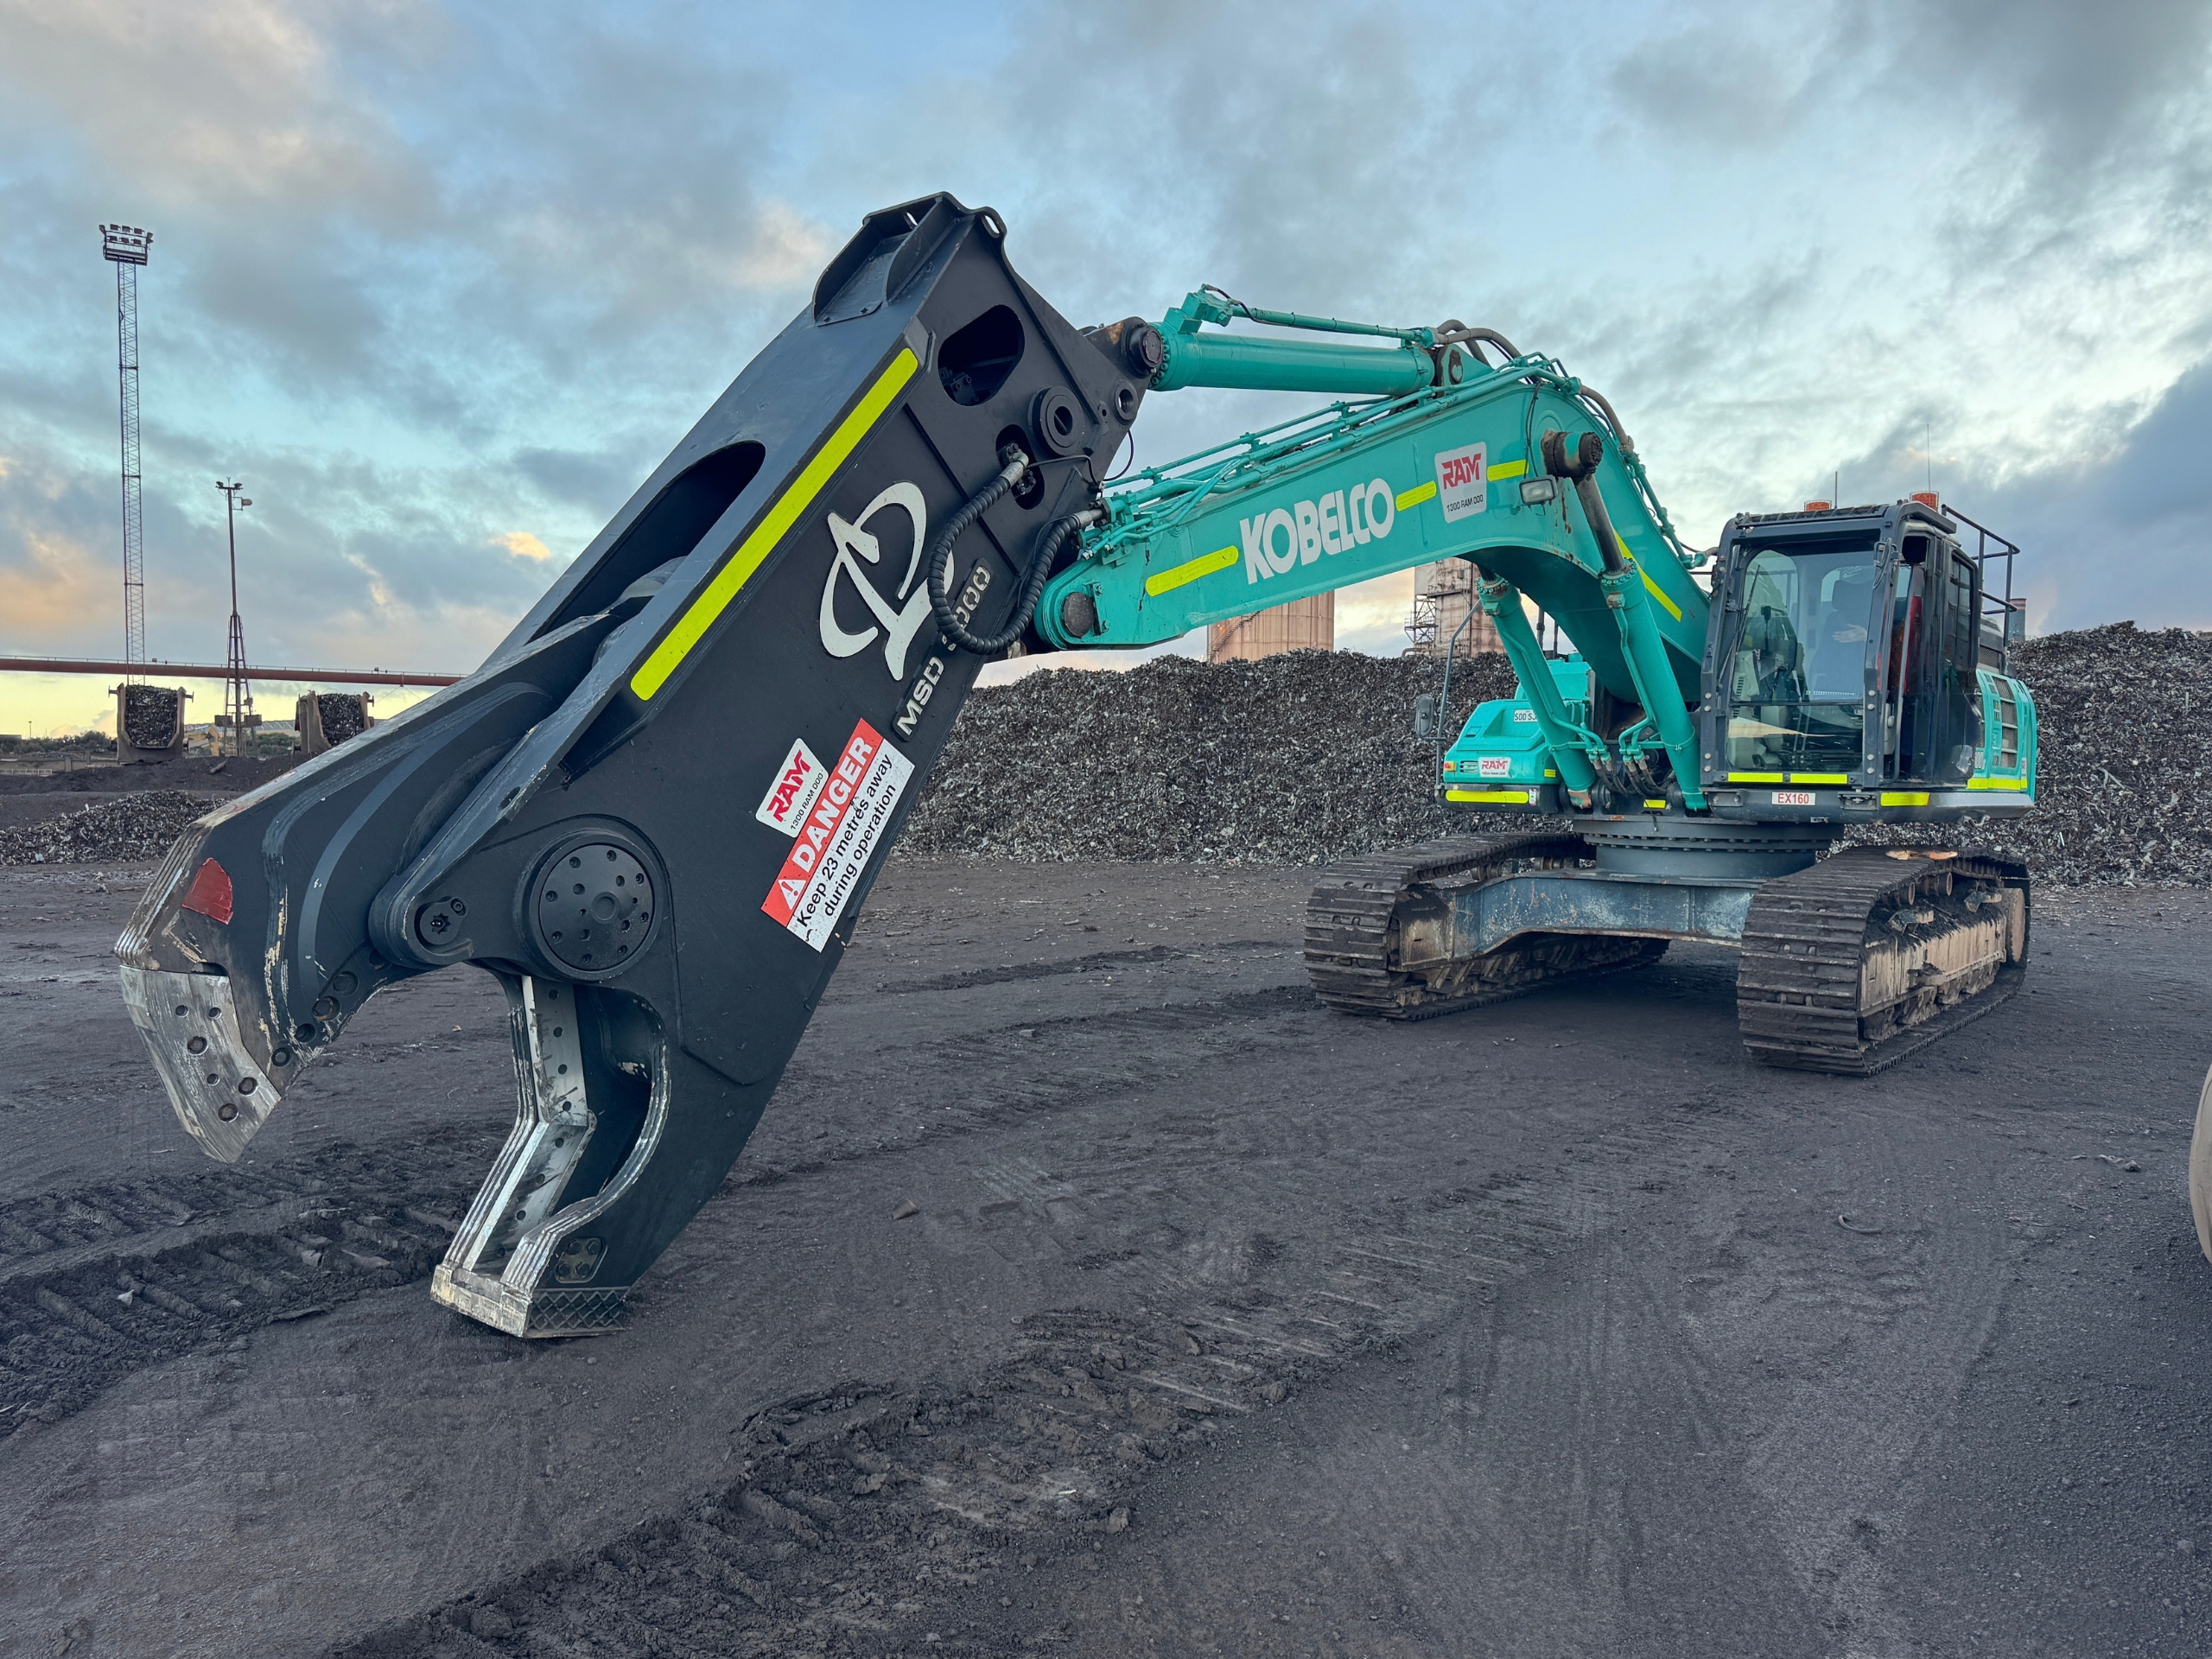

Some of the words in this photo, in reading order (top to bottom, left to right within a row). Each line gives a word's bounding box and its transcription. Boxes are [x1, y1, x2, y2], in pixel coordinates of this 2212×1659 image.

[1441, 453, 1481, 489] RAM
[1446, 502, 1460, 512] 1300
[1461, 499, 1472, 508] RAM
[1473, 494, 1483, 504] 000
[1239, 478, 1395, 585] KOBELCO
[897, 657, 944, 735] MSD
[766, 749, 810, 823] RAM
[791, 809, 804, 830] 1300
[802, 790, 815, 809] RAM
[812, 772, 823, 790] 000
[1482, 760, 1508, 769] RAM
[1777, 793, 1809, 804] EX160
[792, 737, 873, 873] DANGER
[797, 883, 827, 927] Keep
[822, 857, 839, 880] 23
[836, 800, 869, 857] metres
[867, 753, 893, 797] away
[824, 862, 858, 917] during
[854, 785, 896, 861] operation
